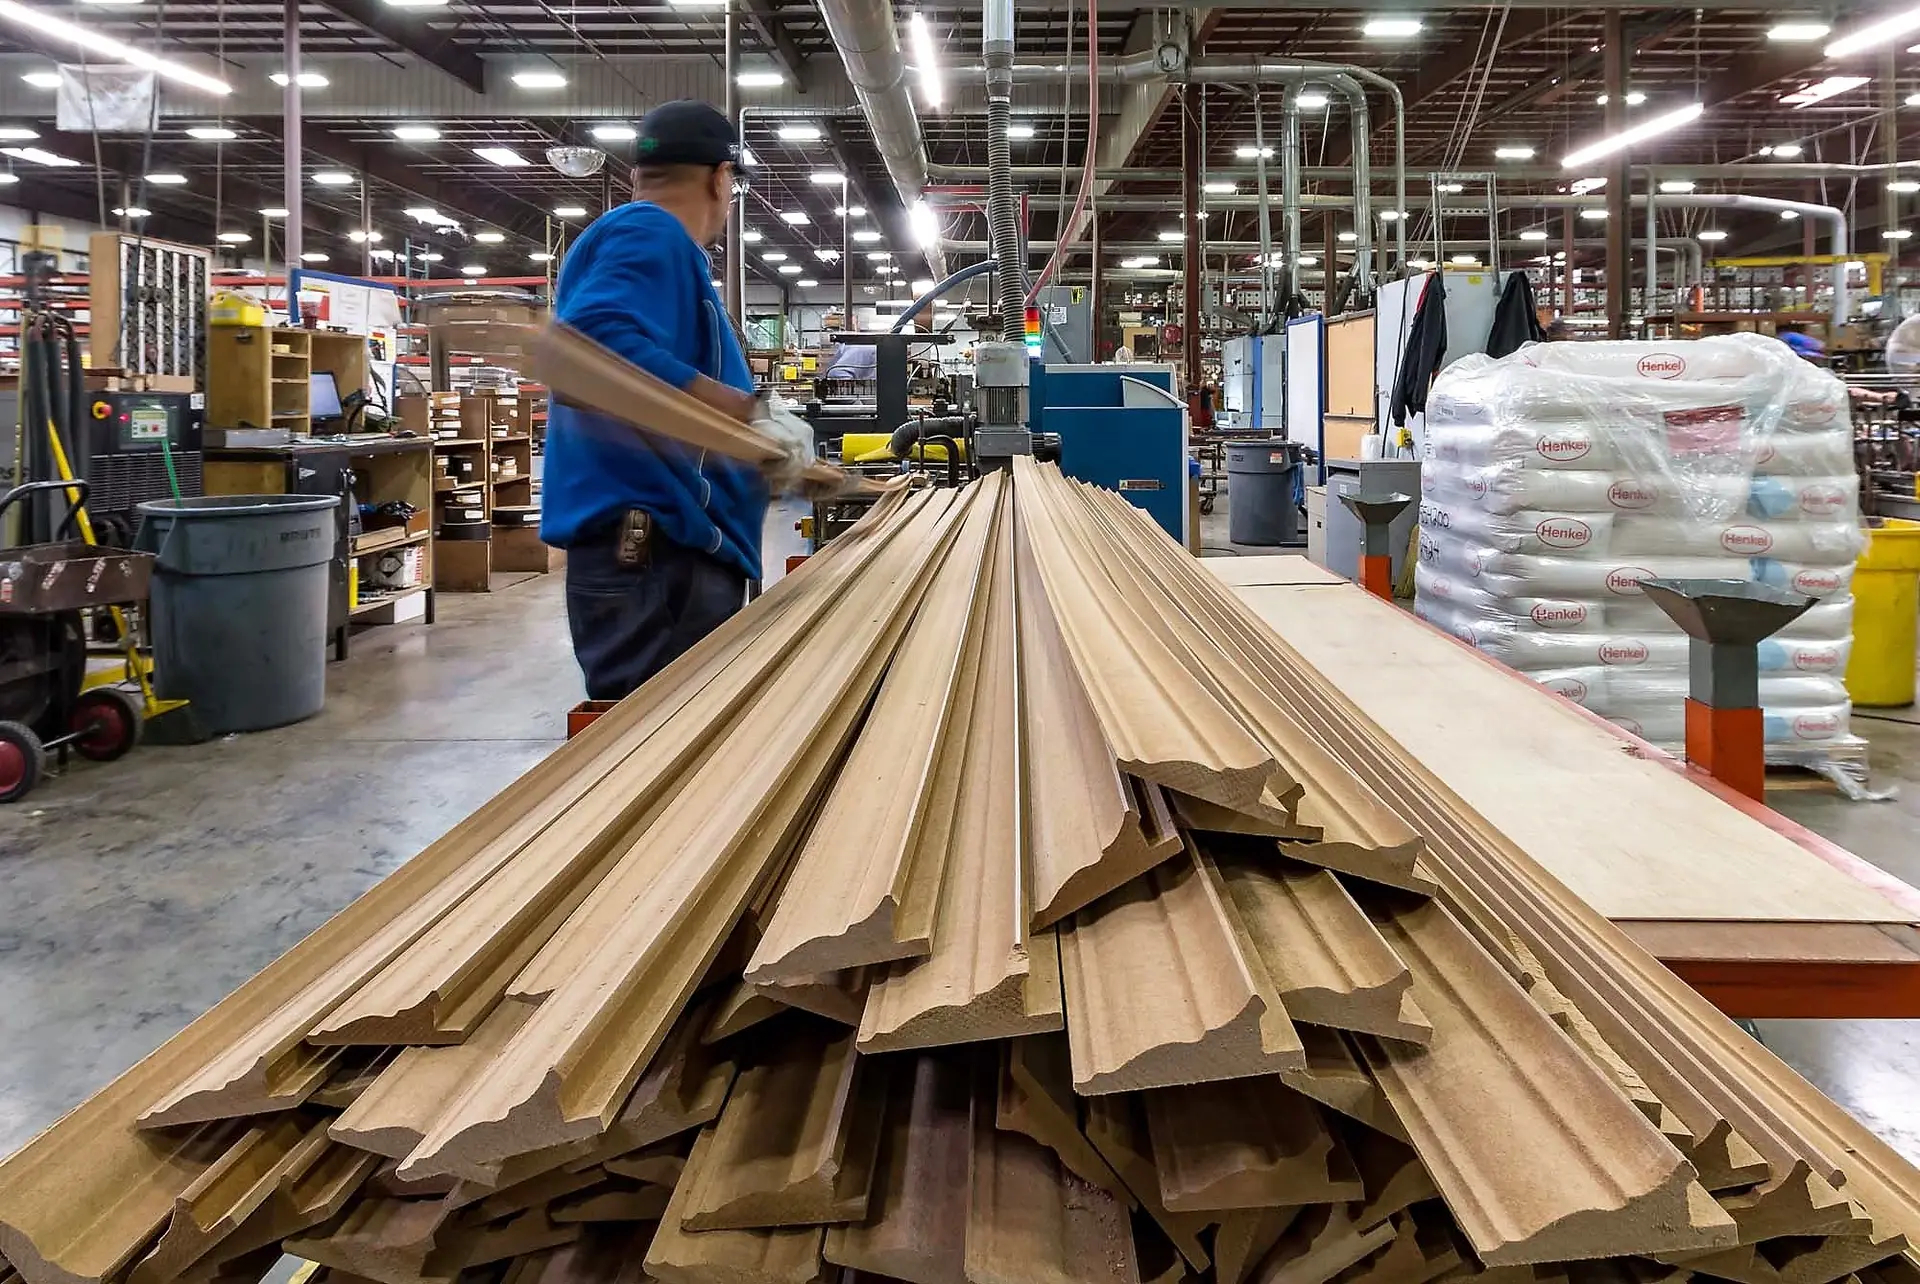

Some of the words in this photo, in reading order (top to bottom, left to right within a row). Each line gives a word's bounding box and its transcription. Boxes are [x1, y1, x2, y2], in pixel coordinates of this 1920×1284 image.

[1641, 361, 1681, 372] Henkel
[1541, 440, 1587, 452] Henkel
[1541, 525, 1587, 540] Henkel
[1725, 534, 1768, 546] Henkel
[1536, 608, 1582, 620] Henkel
[1603, 647, 1645, 659] Henkel
